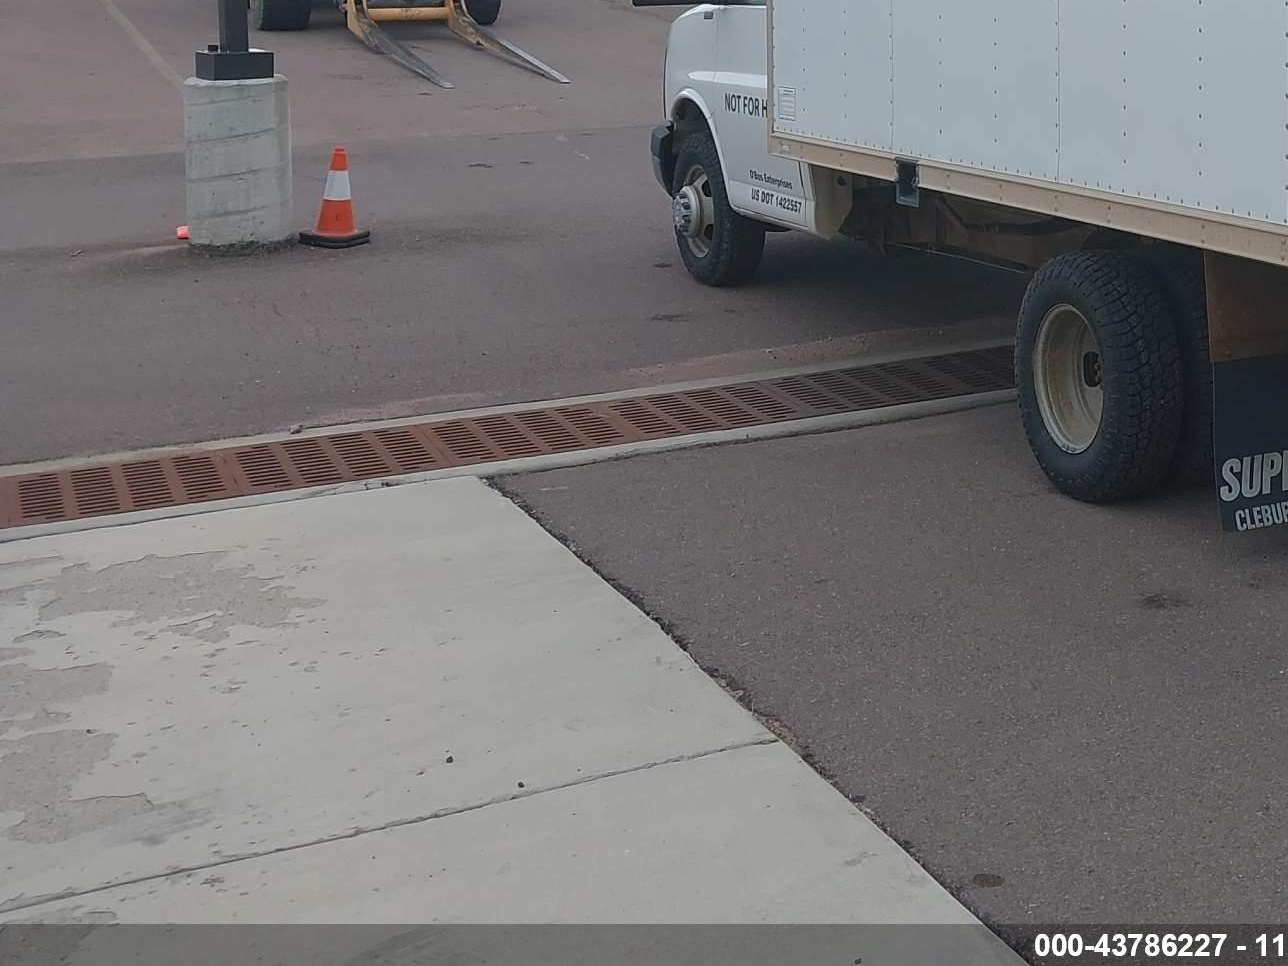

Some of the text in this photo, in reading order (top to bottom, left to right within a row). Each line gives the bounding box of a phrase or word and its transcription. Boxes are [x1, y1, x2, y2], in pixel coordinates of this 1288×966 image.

[725, 93, 741, 113] NOT
[743, 96, 760, 116] FOR
[751, 188, 760, 202] US
[761, 191, 774, 205] DOT
